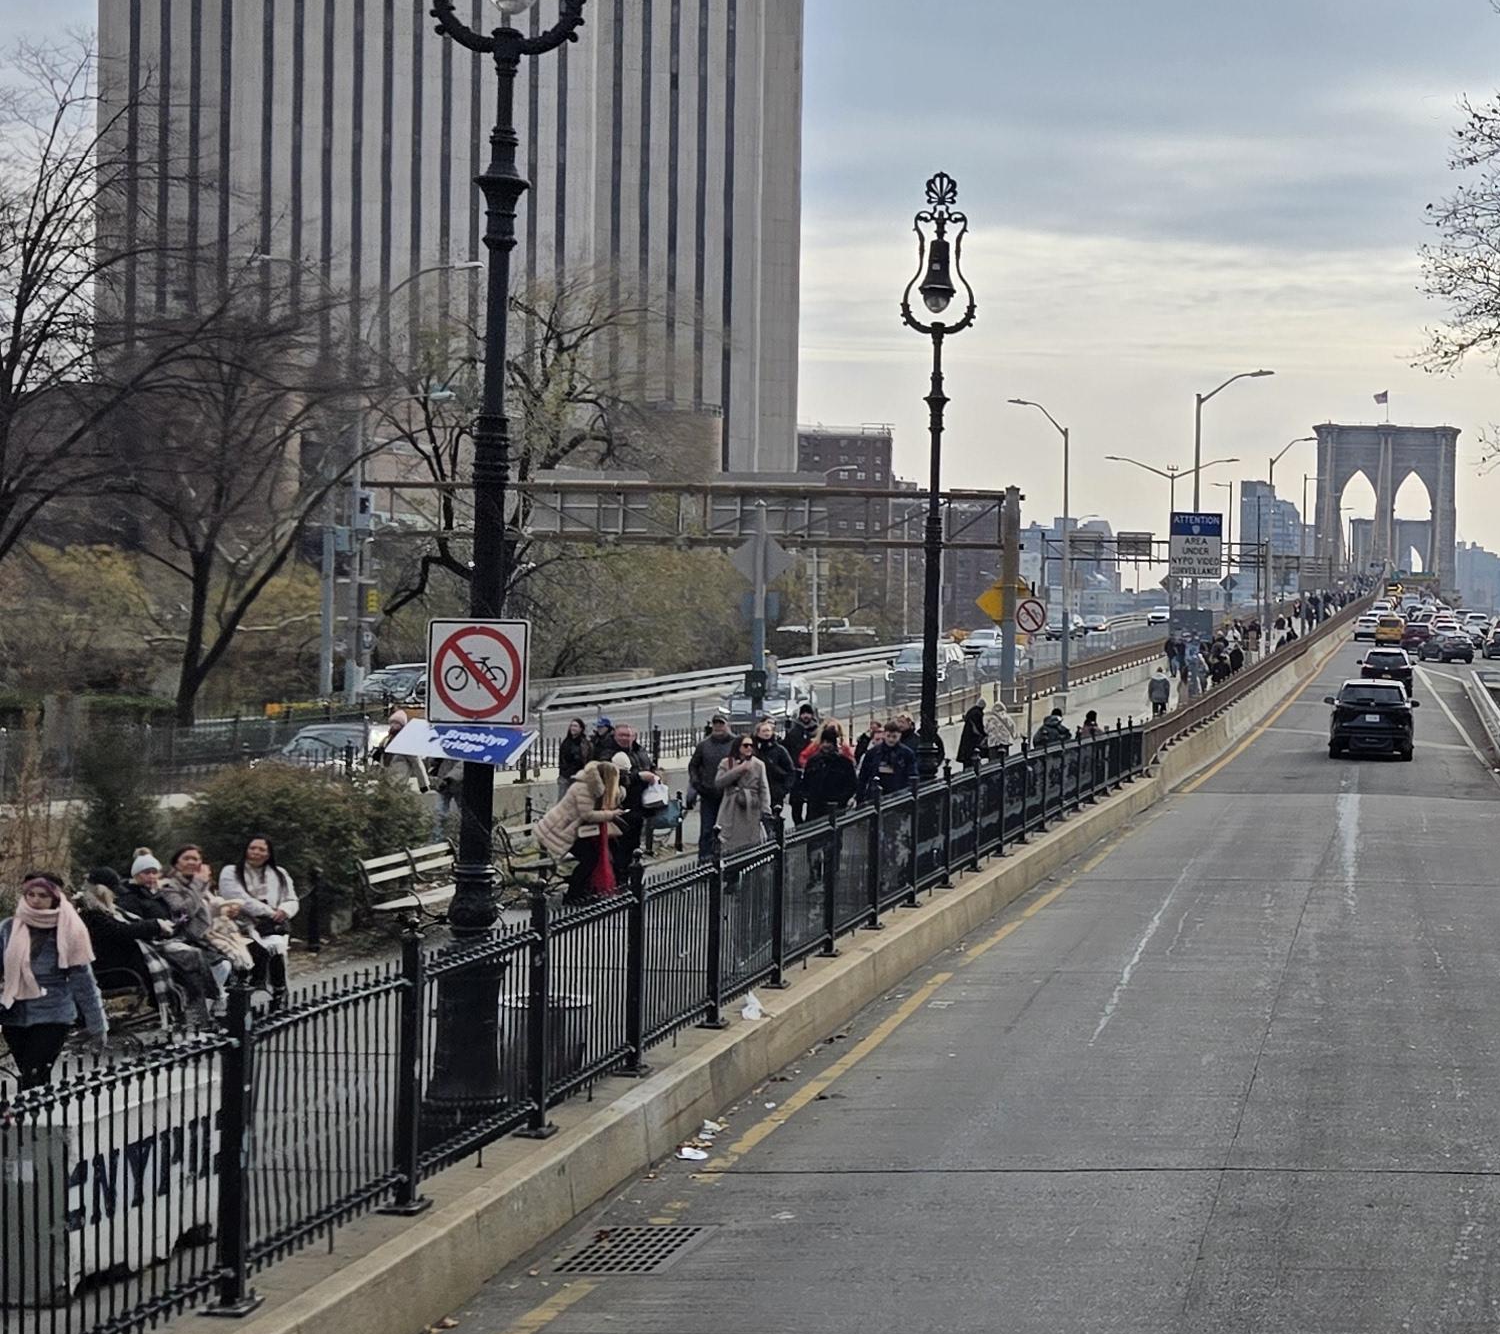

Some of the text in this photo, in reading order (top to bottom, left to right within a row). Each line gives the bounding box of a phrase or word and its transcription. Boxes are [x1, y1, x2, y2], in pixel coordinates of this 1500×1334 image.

[1174, 515, 1220, 525] ATTENTION
[1185, 537, 1208, 545] AREA
[1183, 547, 1209, 555] UNDER
[1171, 556, 1220, 566] NYPD VIDEO
[1171, 567, 1220, 576] SURVEILLANCE
[446, 728, 509, 747] Brooklyn
